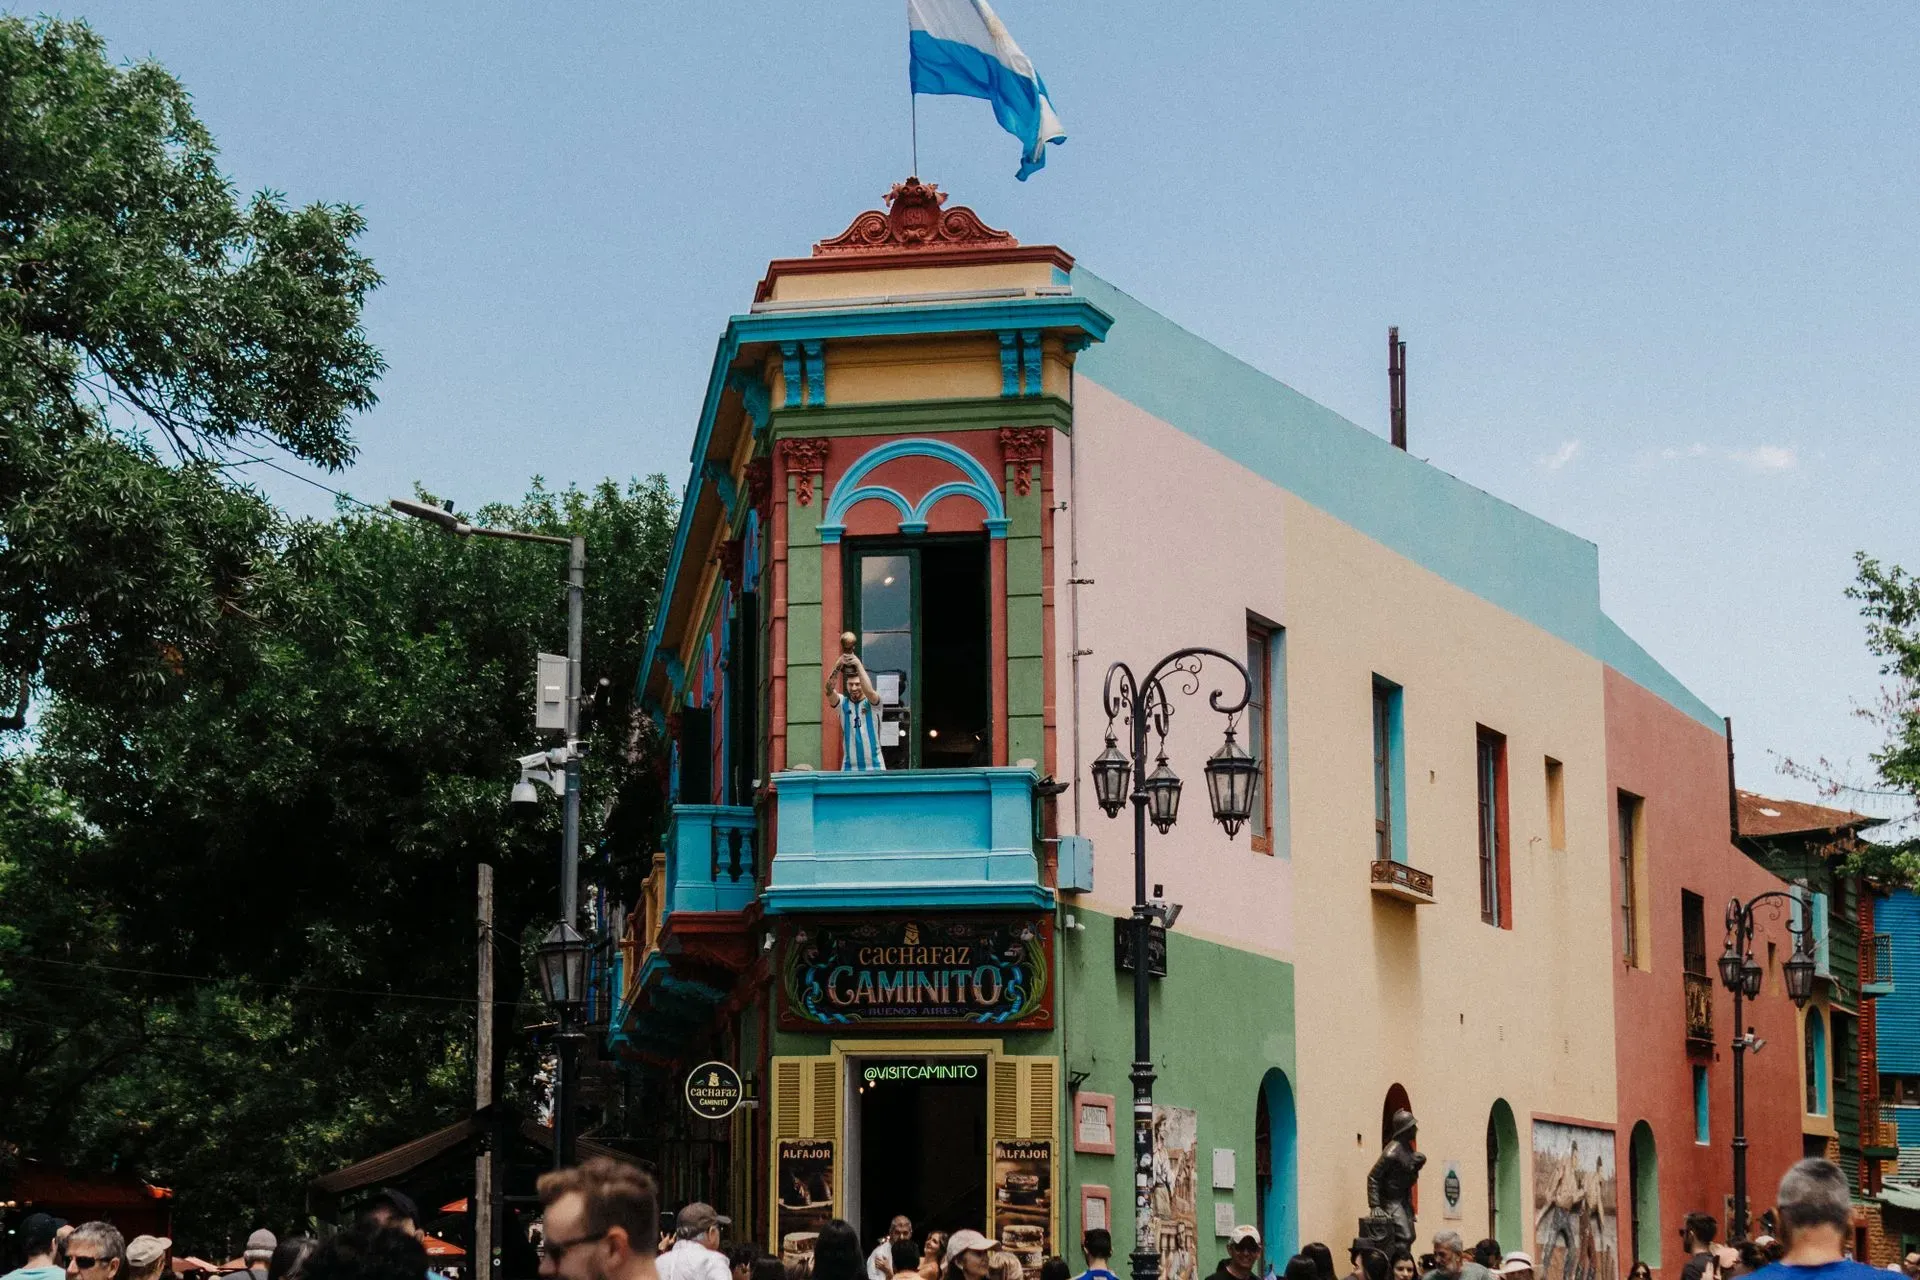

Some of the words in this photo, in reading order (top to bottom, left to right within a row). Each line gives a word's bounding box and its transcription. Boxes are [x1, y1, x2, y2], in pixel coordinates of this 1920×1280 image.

[827, 965, 1002, 1005] CAMINITO
[868, 1007, 918, 1016] BUENOS
[922, 1006, 958, 1015] AIRES
[864, 1065, 978, 1081] @VISITCAMINITO
[699, 1098, 728, 1106] CAMINITO
[783, 1149, 831, 1159] ALFAJOR
[1000, 1149, 1048, 1159] ALFAJOR
